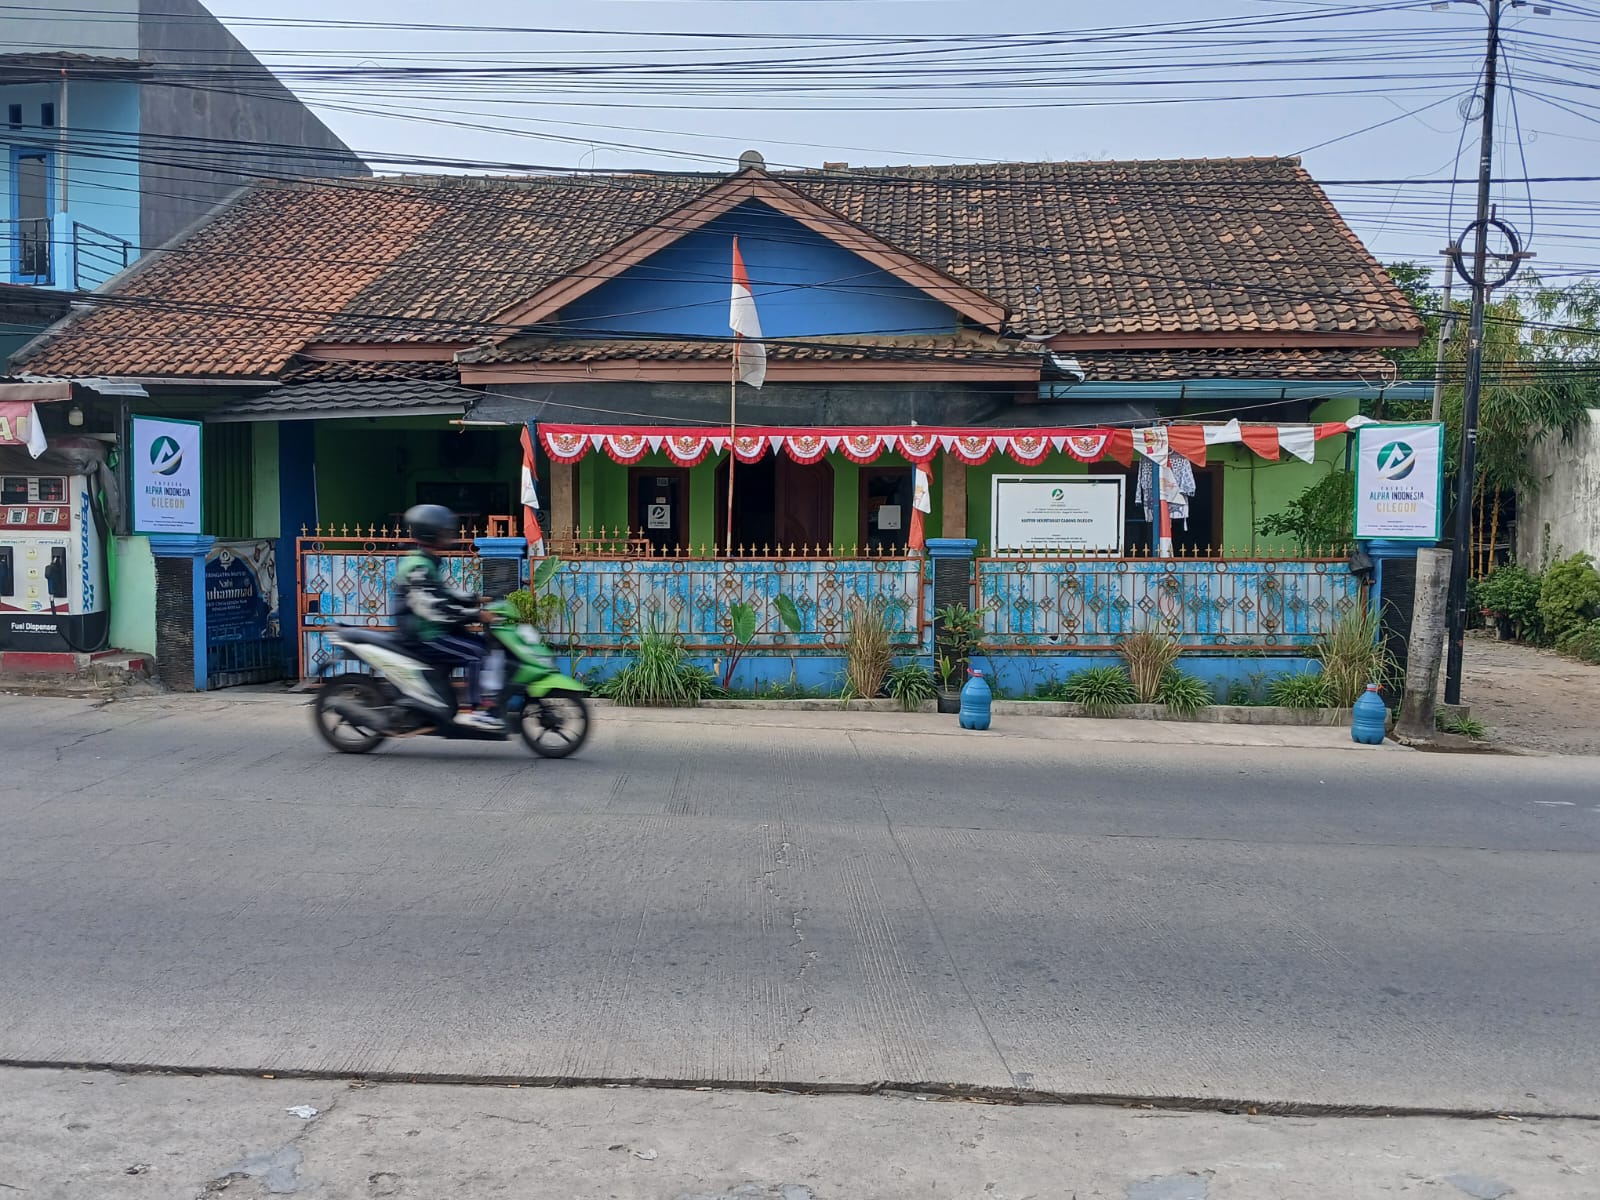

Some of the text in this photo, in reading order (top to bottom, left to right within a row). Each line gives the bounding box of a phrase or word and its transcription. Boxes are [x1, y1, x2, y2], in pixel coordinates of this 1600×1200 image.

[145, 486, 190, 496] ALPHA INDONESIA
[1369, 491, 1424, 501] ALPHA INDONESIA
[151, 497, 184, 508] CILEGON
[1376, 502, 1416, 512] CILEGON
[80, 491, 89, 612] PERTAMAX
[206, 584, 253, 600] uhammad
